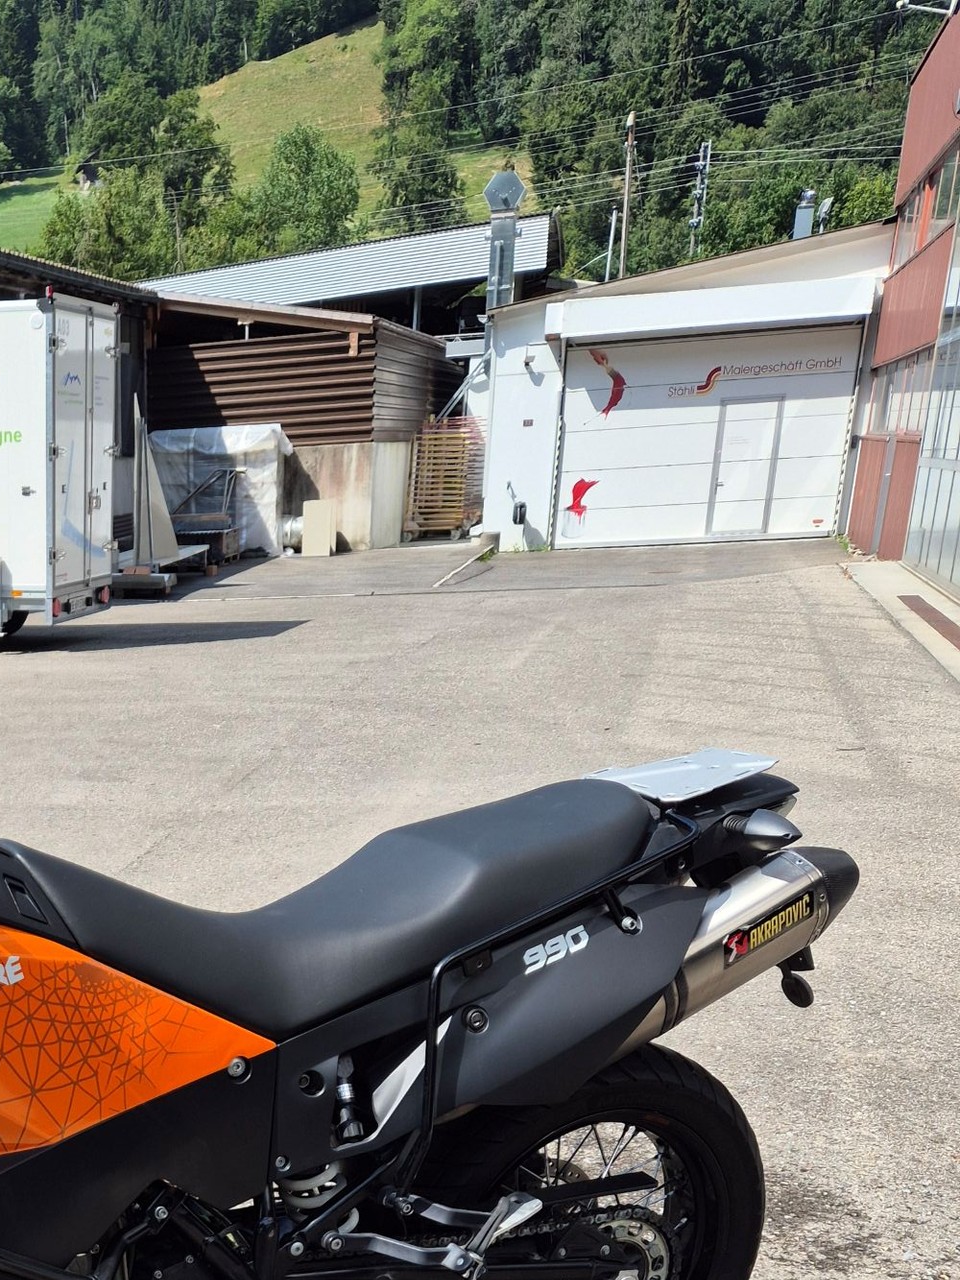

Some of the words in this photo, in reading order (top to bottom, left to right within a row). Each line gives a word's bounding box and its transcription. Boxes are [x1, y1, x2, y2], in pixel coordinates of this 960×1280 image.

[723, 359, 803, 376] Malergeschäft
[806, 356, 842, 370] GmbH
[523, 924, 590, 976] 990
